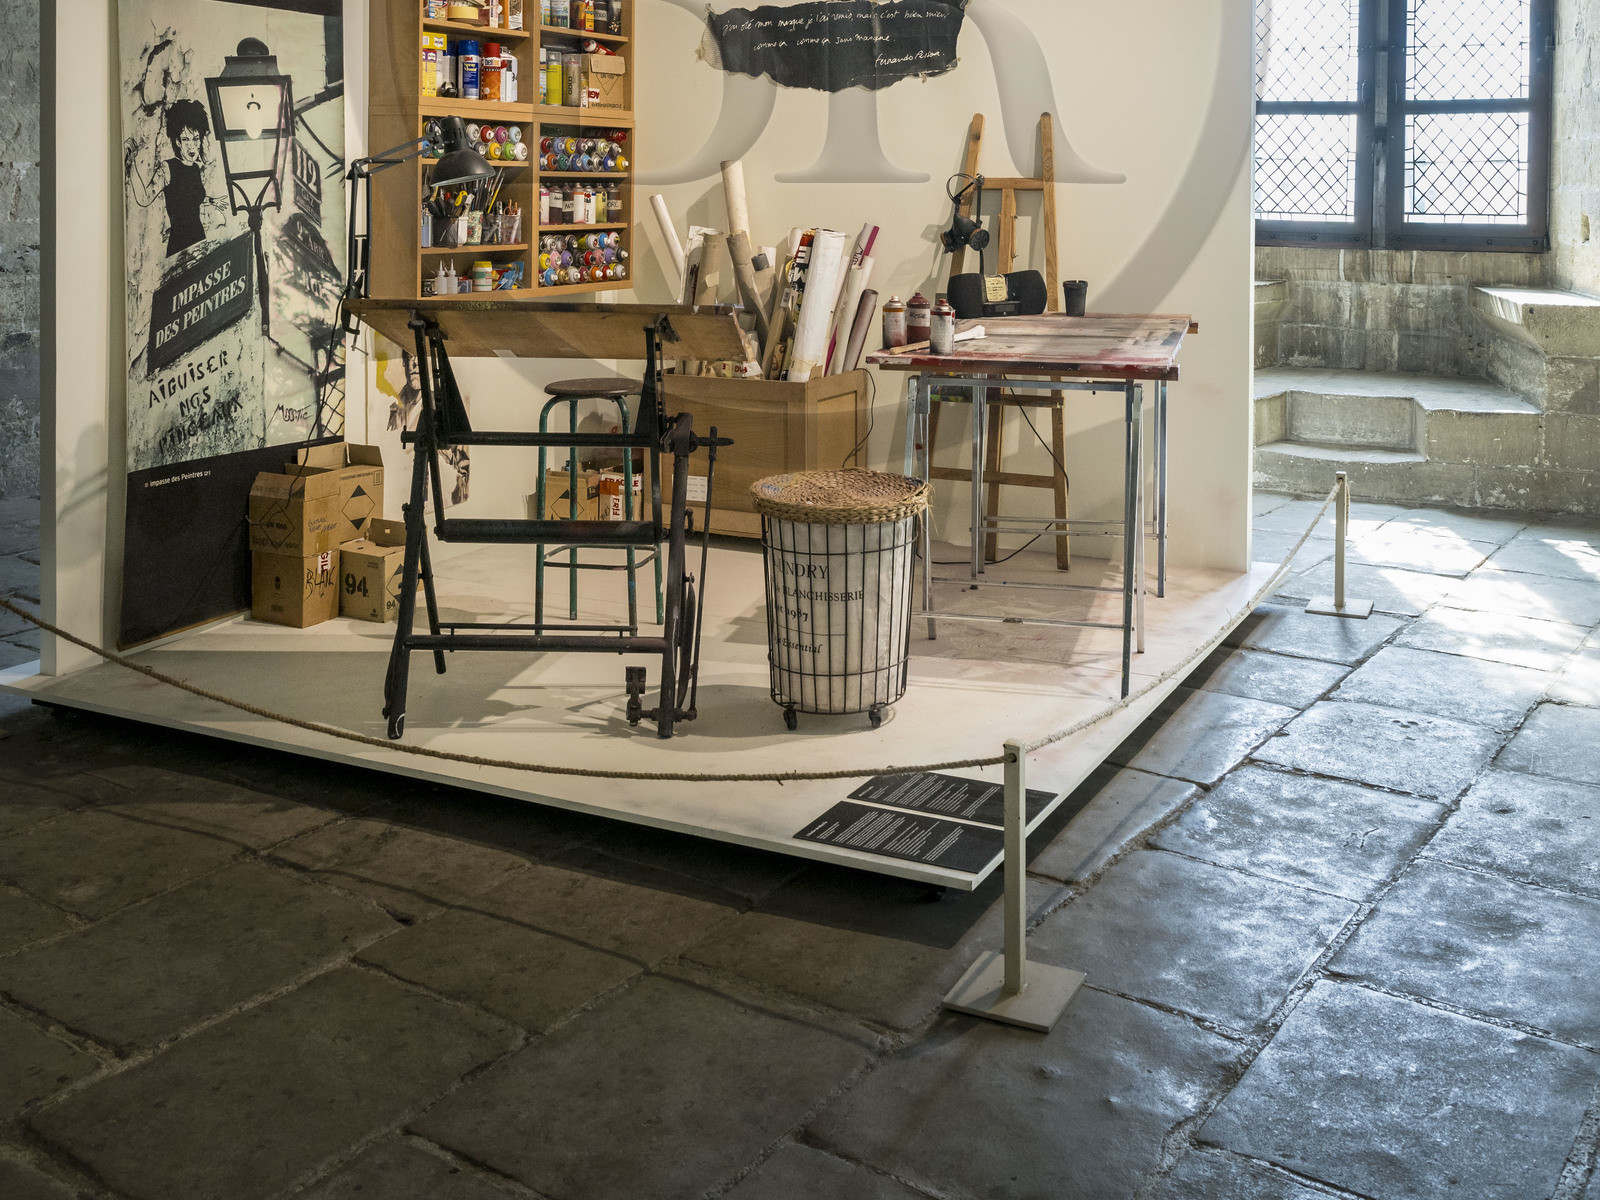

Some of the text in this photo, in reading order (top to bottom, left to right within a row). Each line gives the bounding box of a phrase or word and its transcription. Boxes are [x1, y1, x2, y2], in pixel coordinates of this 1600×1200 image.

[155, 275, 247, 350] DES PEINTRES
[171, 260, 231, 314] IMPASSE
